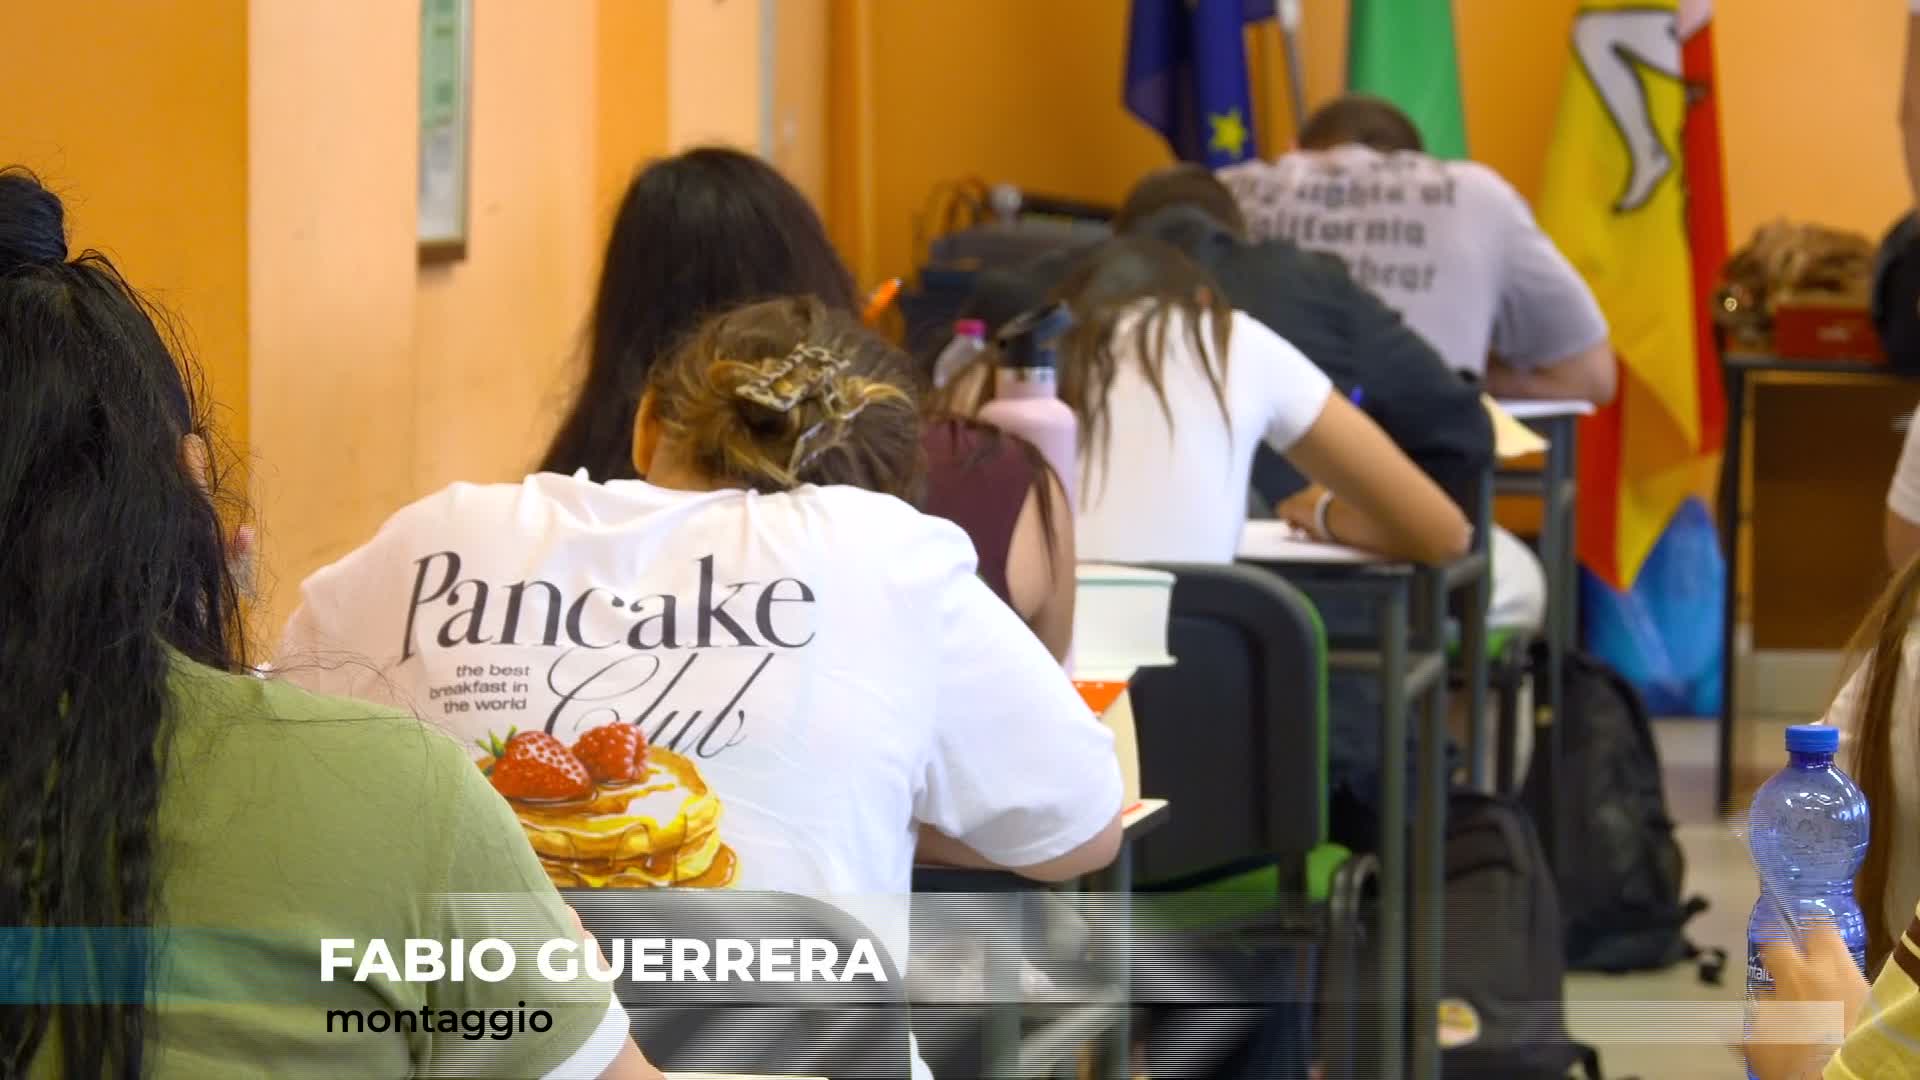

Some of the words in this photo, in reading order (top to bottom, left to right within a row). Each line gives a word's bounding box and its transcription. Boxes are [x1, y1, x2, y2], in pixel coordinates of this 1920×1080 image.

[1248, 208, 1426, 246] alifornia
[401, 550, 816, 664] Pancake
[456, 664, 484, 678] the
[489, 664, 530, 677] best
[429, 681, 507, 699] breakfast
[512, 681, 529, 693] in
[444, 700, 470, 714] the
[475, 698, 527, 711] world
[543, 650, 776, 759] Club
